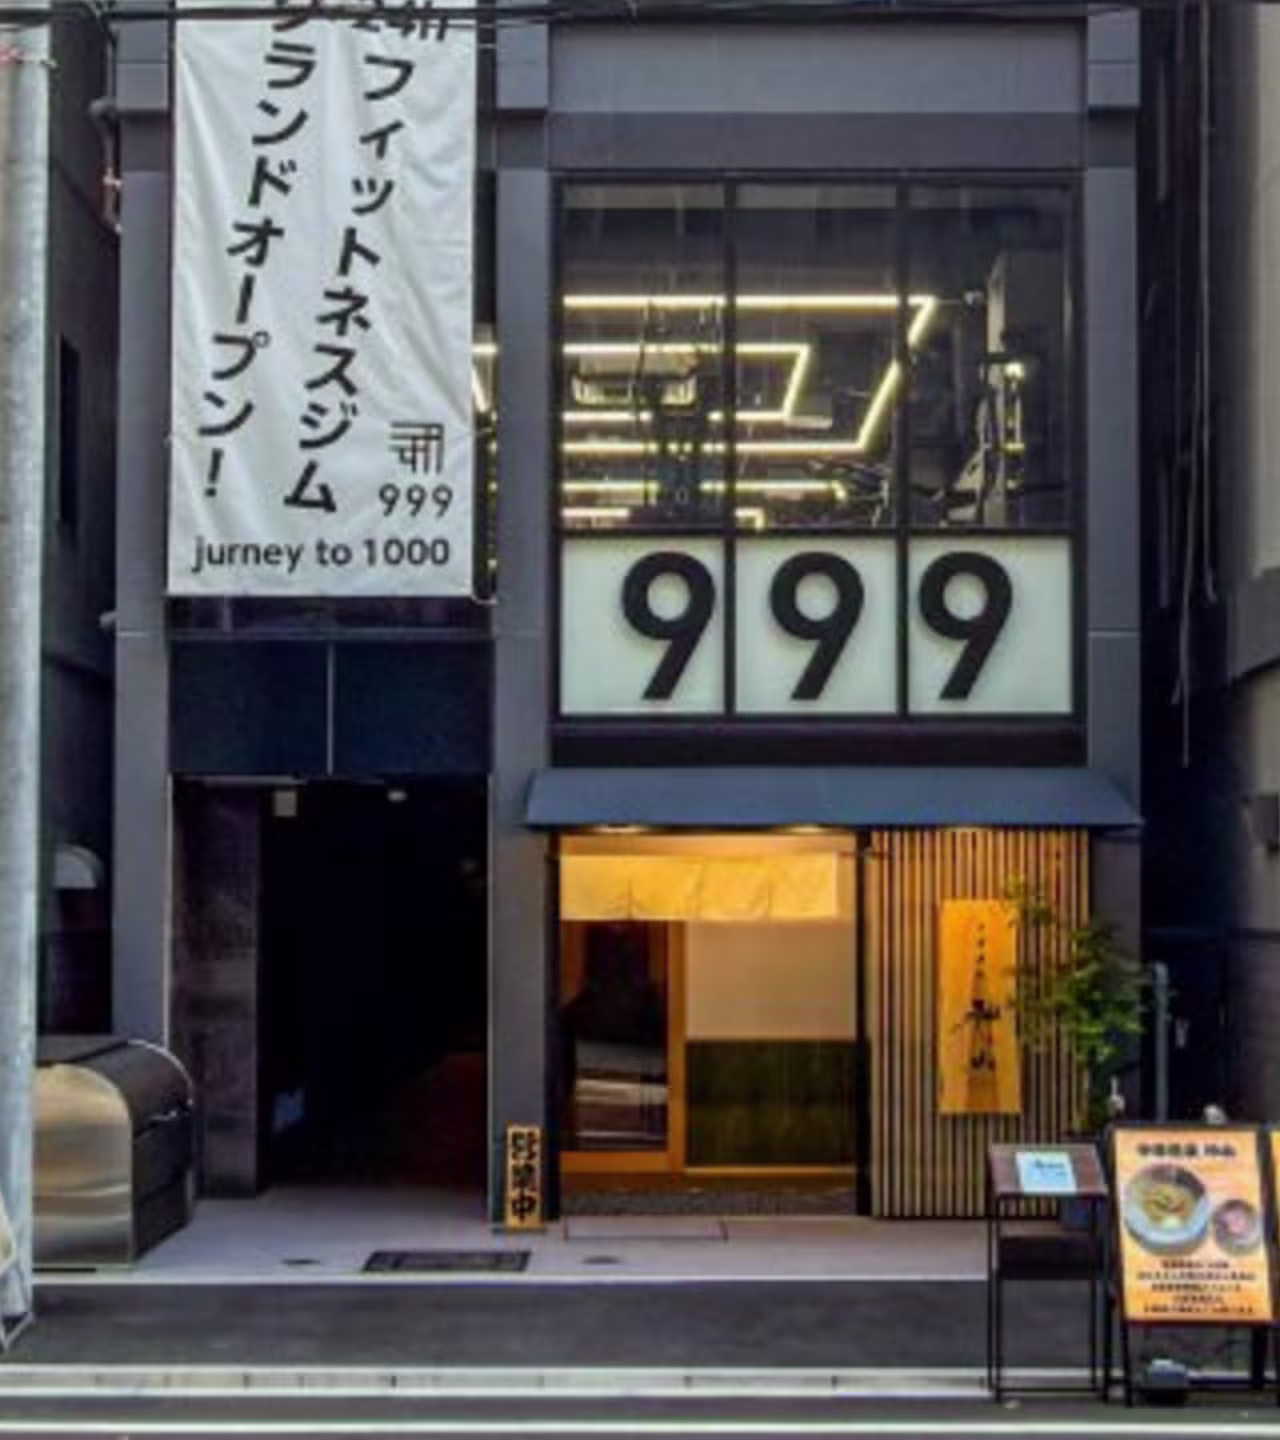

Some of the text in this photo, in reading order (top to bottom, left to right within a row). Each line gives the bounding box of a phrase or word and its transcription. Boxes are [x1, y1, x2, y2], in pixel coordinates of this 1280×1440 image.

[283, 54, 415, 513] フィットネスジム
[379, 482, 454, 517] 999
[191, 536, 450, 574] jurney to 1000
[621, 551, 1014, 701] 999
